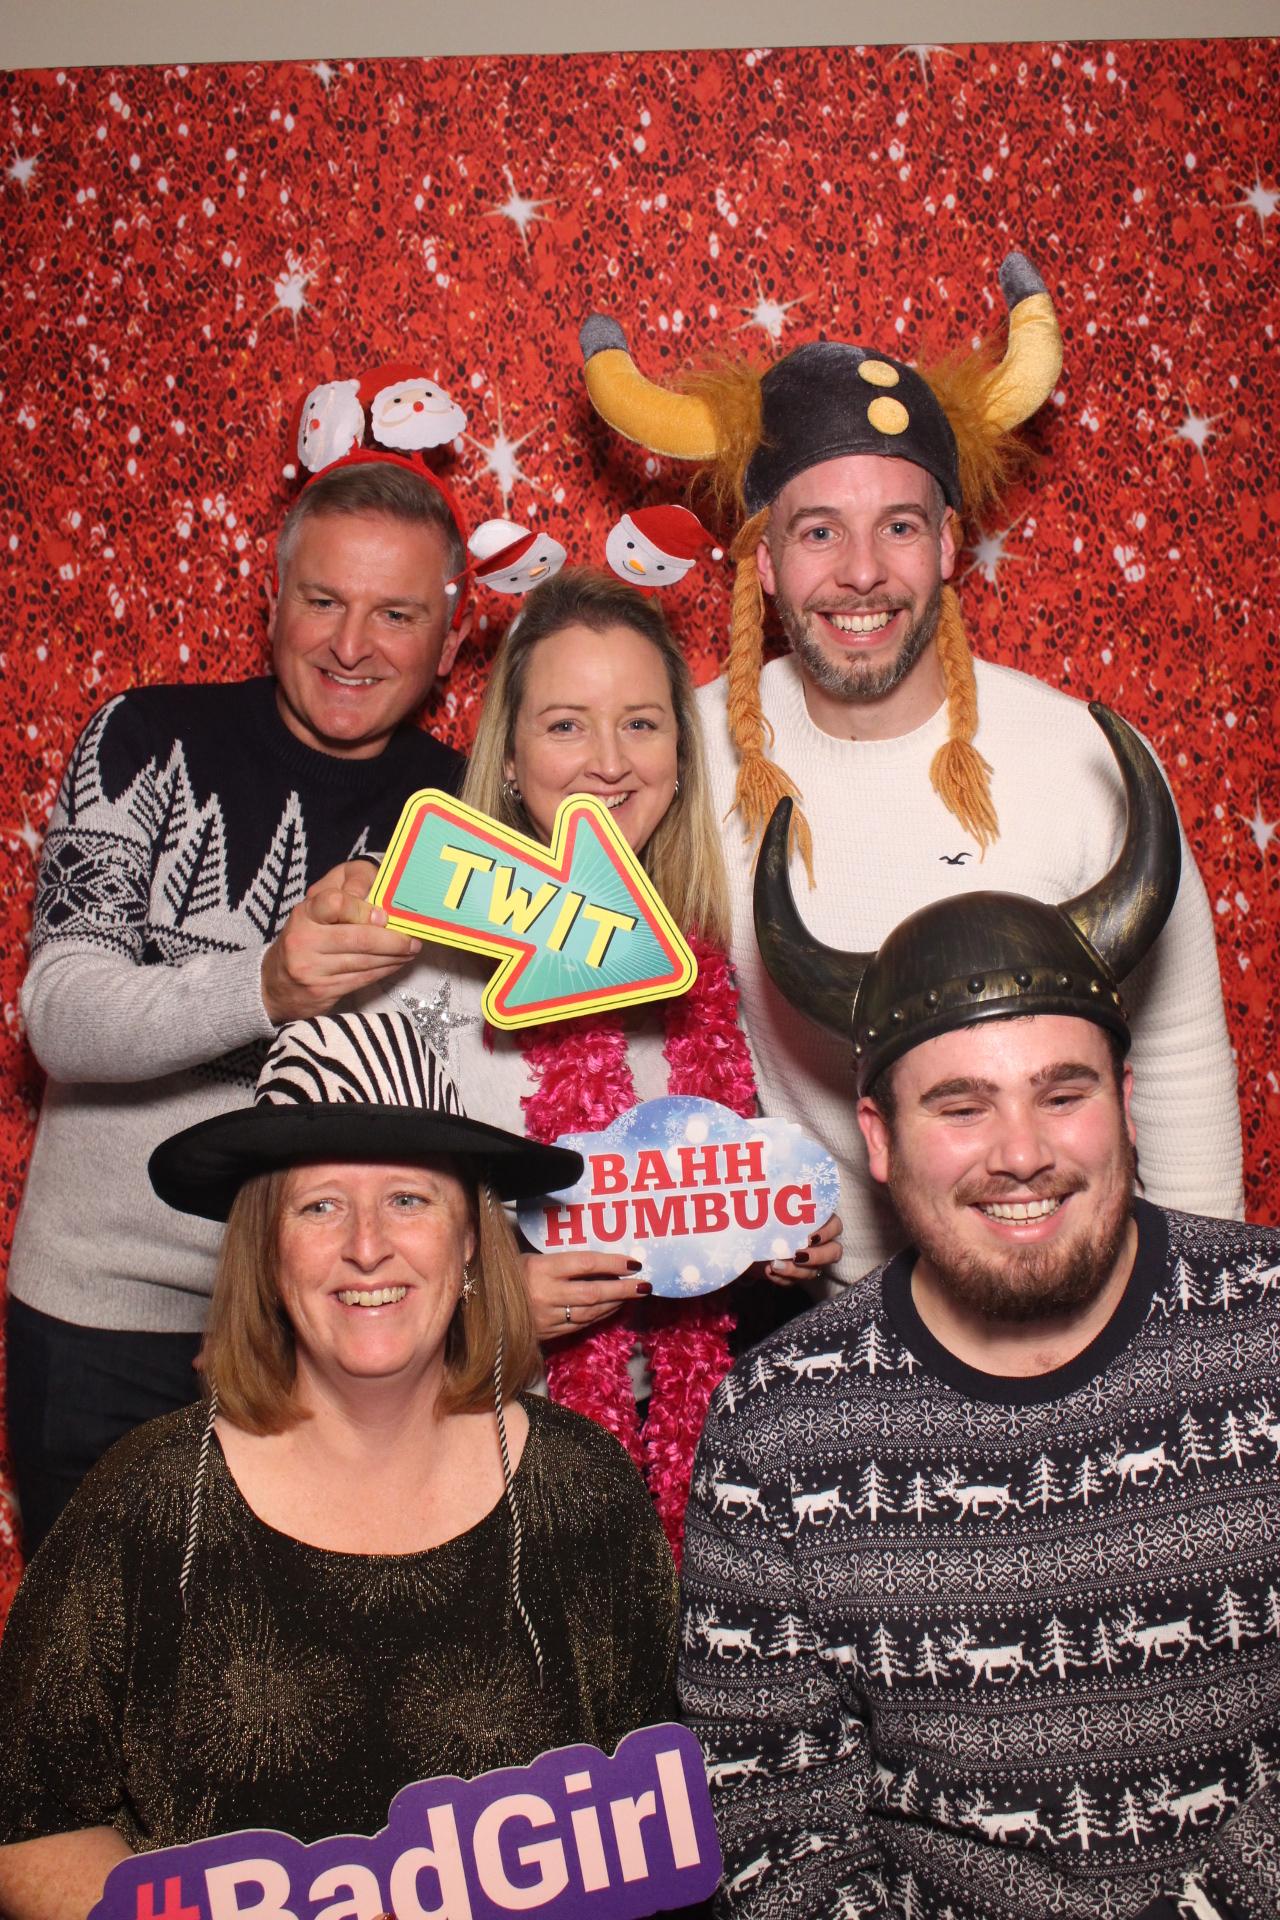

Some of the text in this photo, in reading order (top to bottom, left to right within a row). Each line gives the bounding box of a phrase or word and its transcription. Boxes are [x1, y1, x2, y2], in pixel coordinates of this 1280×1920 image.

[439, 844, 639, 969] TWIT
[588, 1141, 767, 1196] BAHH
[543, 1184, 817, 1247] HUMBUG
